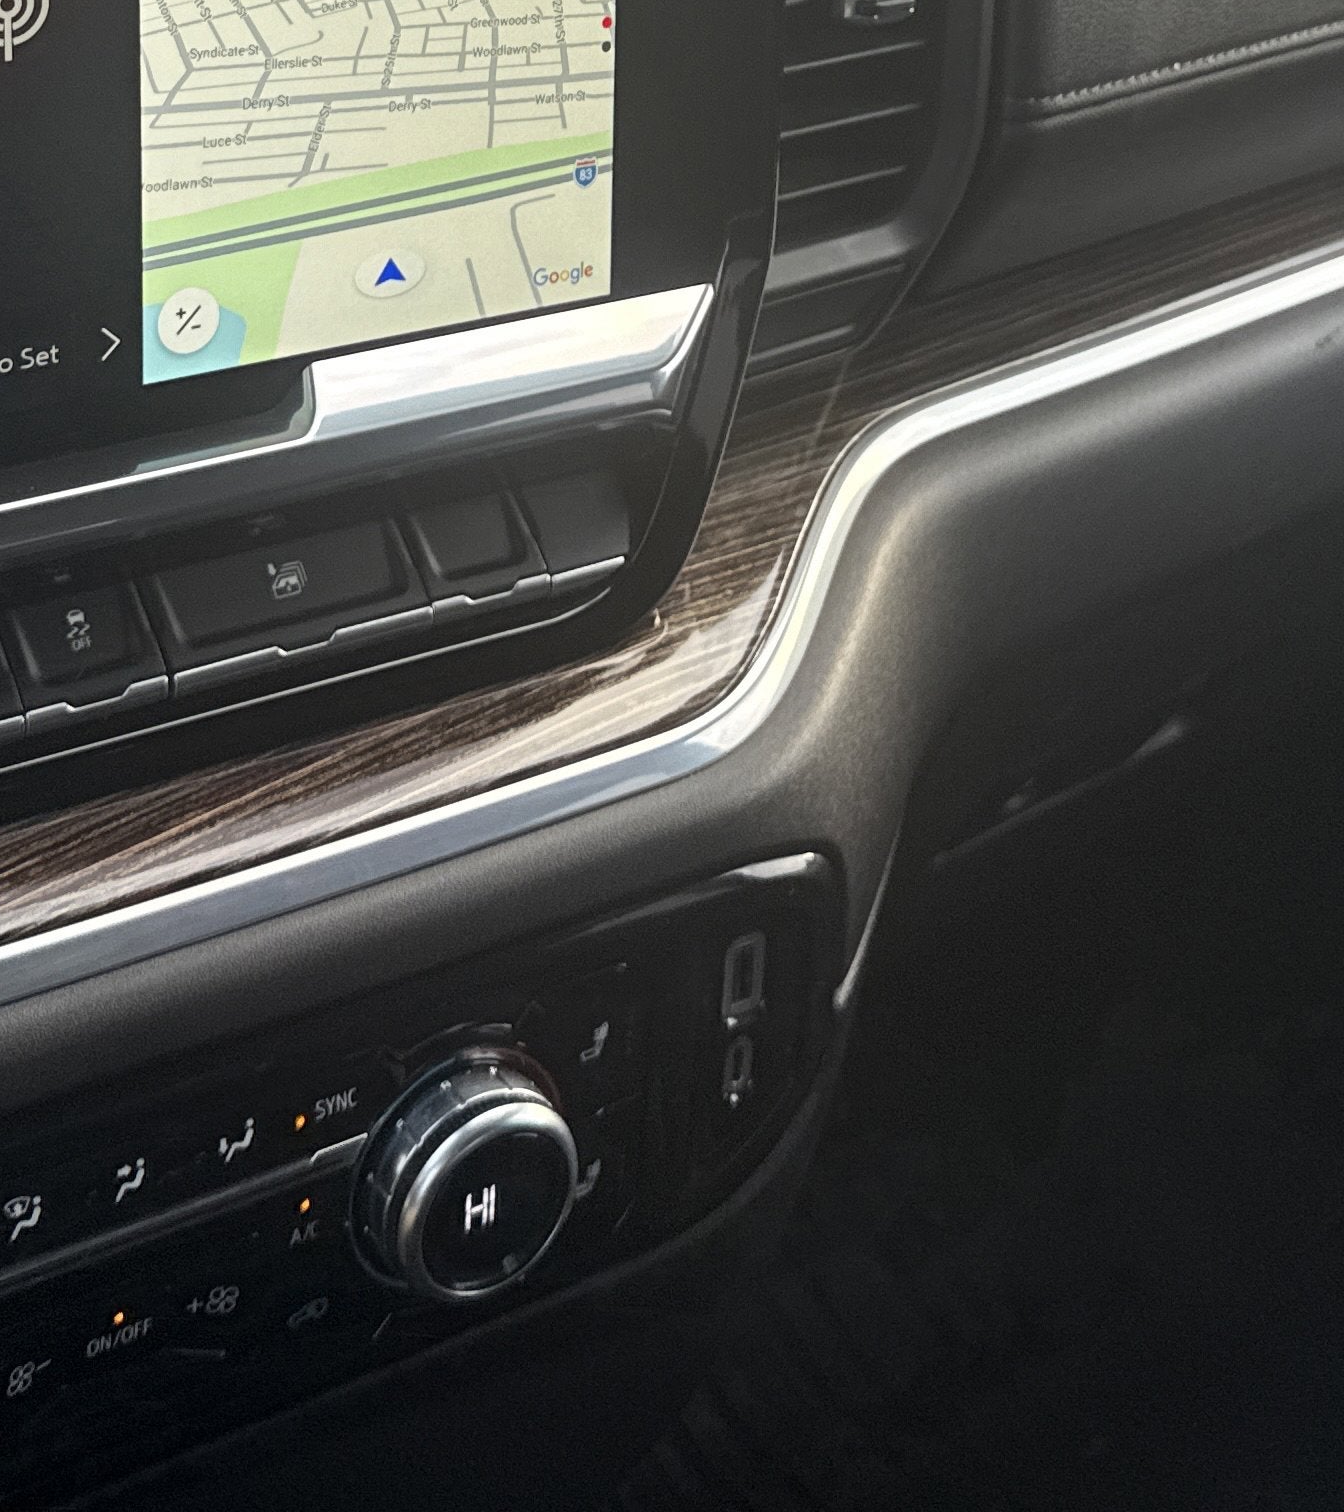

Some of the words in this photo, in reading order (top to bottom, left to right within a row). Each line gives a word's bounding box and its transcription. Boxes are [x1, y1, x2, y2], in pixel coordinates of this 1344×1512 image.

[199, 7, 213, 22] St
[236, 6, 248, 19] St
[321, 0, 347, 14] Duke
[470, 15, 527, 28] Greenwood
[530, 14, 540, 26] St
[167, 22, 180, 36] St
[556, 30, 566, 43] St
[390, 33, 400, 46] St
[189, 47, 244, 60] Syndicate
[248, 44, 259, 55] St
[472, 44, 528, 57] Woodlawn
[530, 42, 541, 54] St
[264, 58, 307, 70] Ellerslie
[312, 55, 323, 67] St
[383, 50, 396, 75] 25th
[381, 77, 391, 86] S
[242, 97, 273, 111] Derry
[276, 95, 290, 108] St
[535, 92, 573, 105] Watson
[575, 89, 586, 102] St
[388, 100, 418, 113] Derry
[420, 98, 432, 110] St
[308, 119, 325, 152] Elder
[319, 104, 331, 118] St
[202, 135, 232, 148] Luce
[234, 133, 247, 146] St
[200, 176, 213, 189] St
[533, 261, 594, 287] Google
[20, 344, 60, 370] Set
[71, 635, 92, 651] OFF
[314, 1086, 358, 1121] SYNC
[464, 1184, 496, 1235] HI
[86, 1317, 153, 1358] ON/OFF
